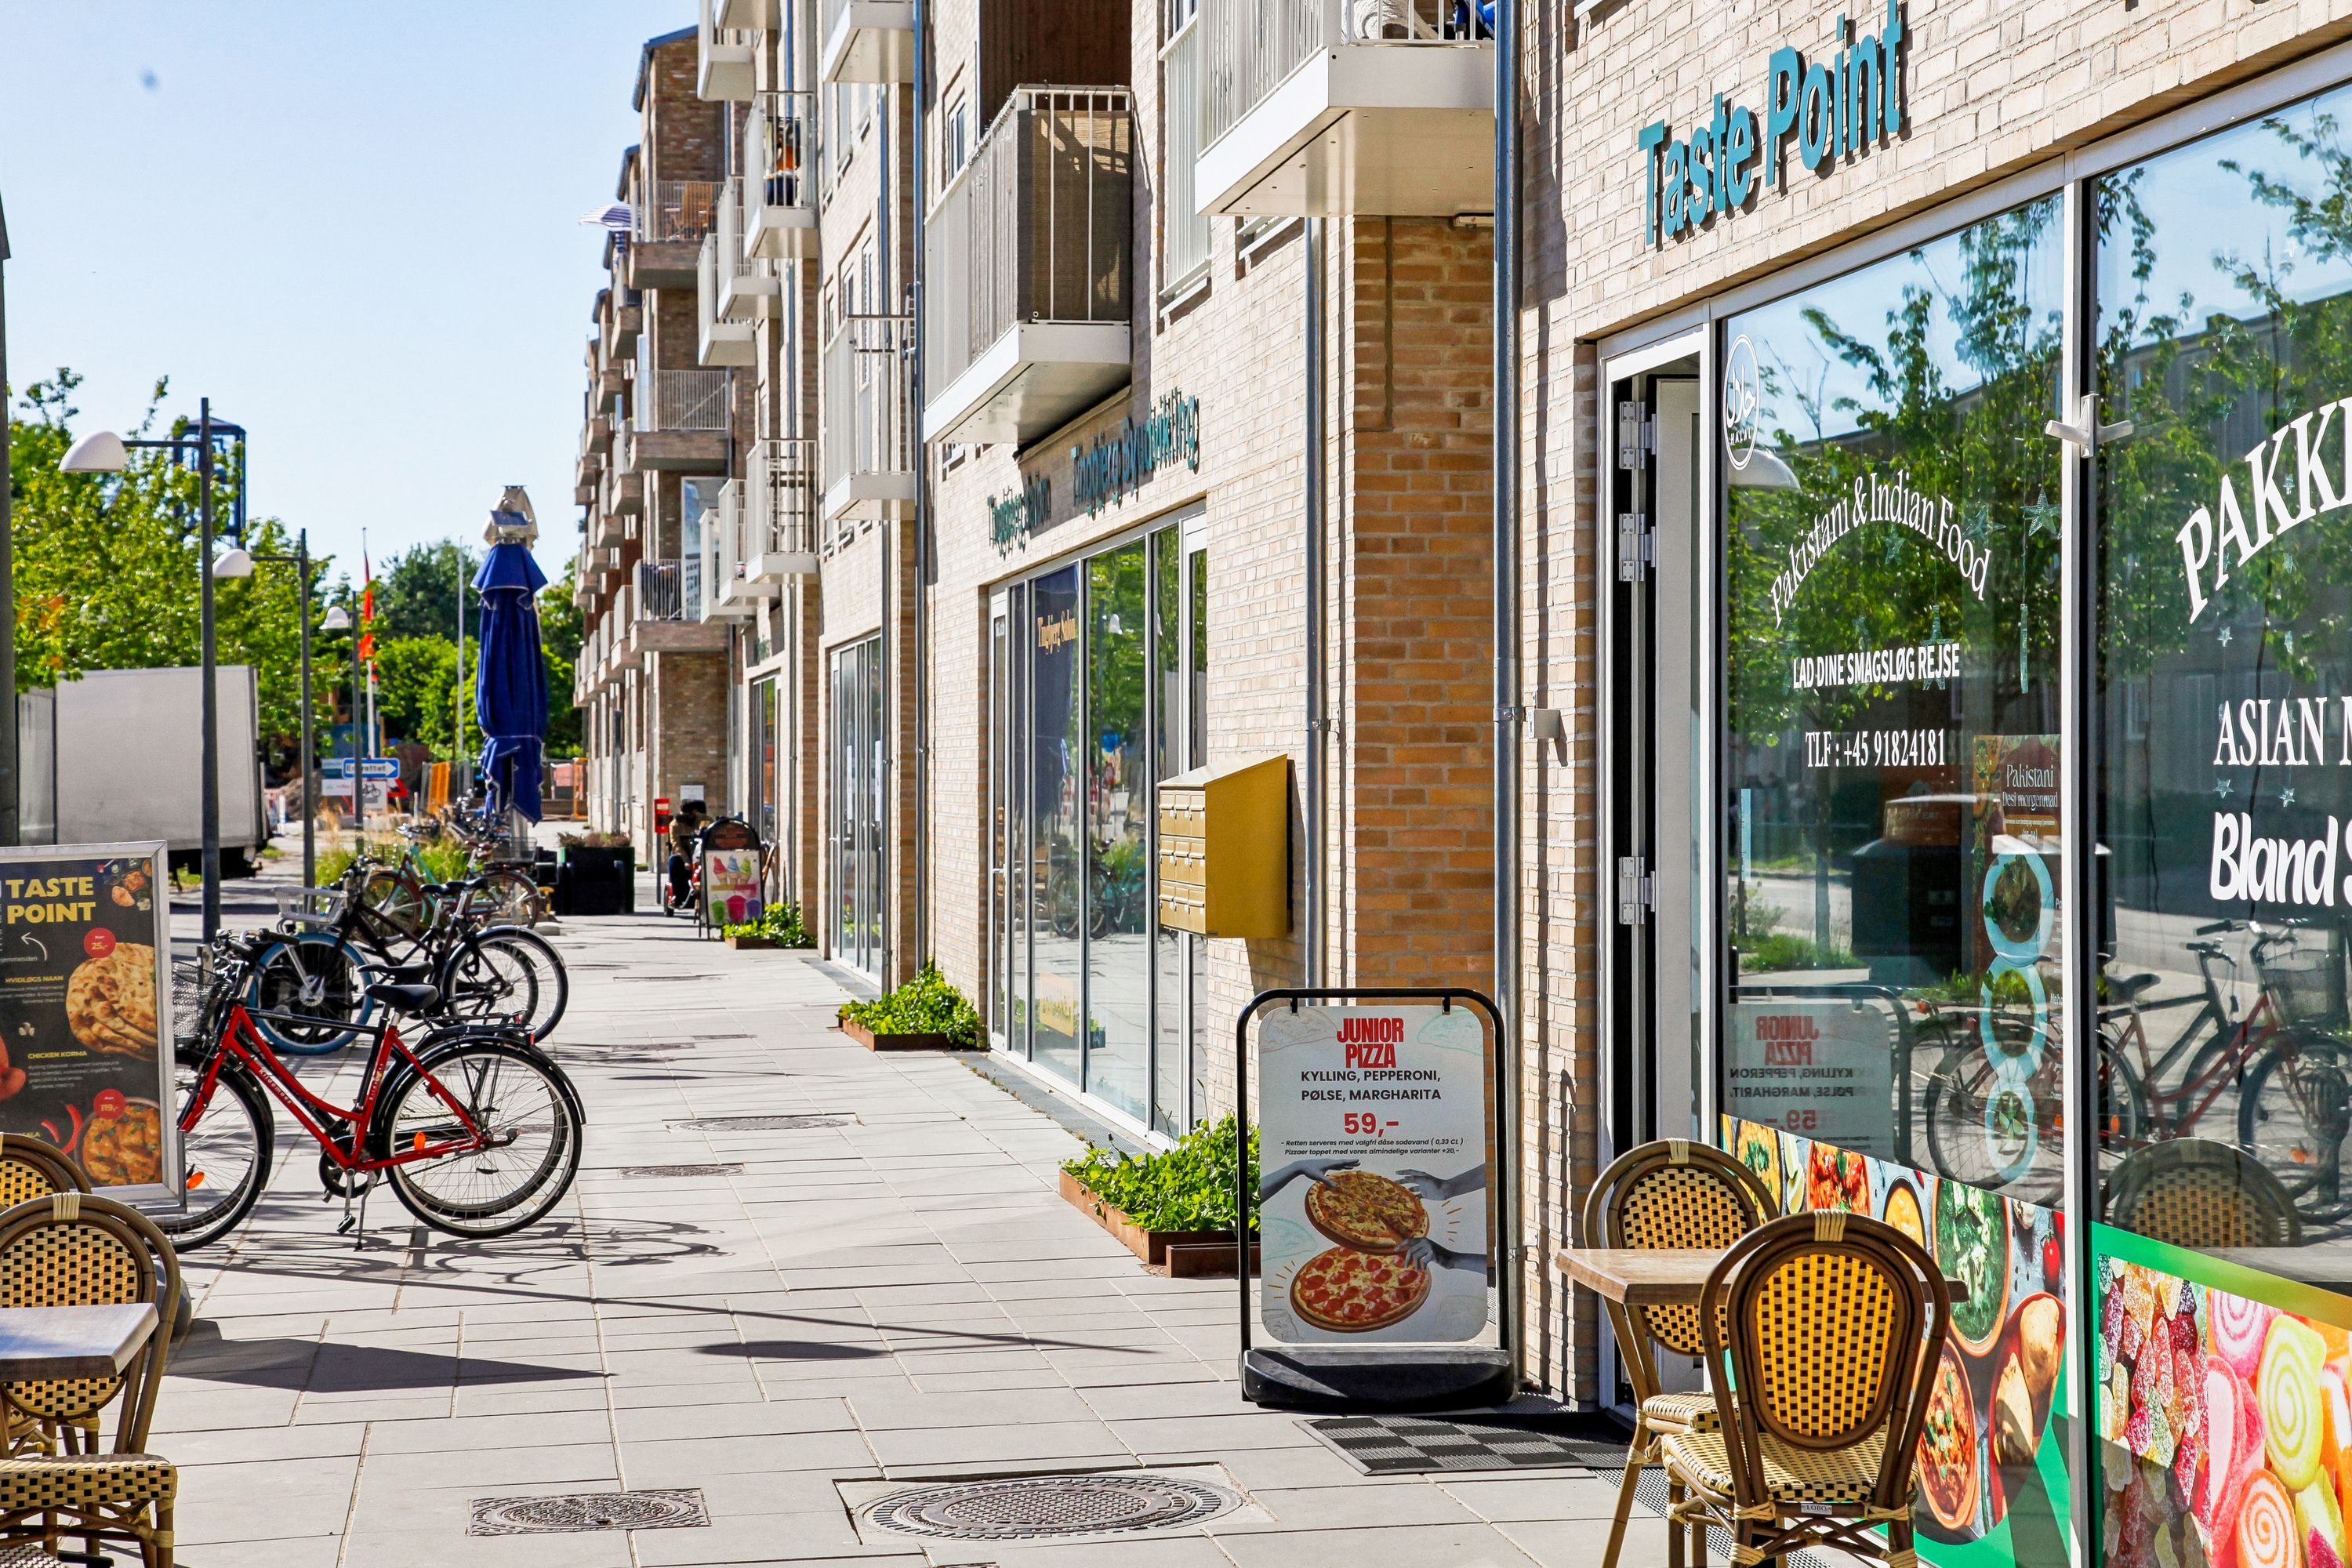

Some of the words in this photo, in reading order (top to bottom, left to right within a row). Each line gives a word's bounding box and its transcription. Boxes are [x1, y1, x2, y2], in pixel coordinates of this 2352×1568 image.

[1639, 92, 1752, 246] Taste
[1766, 0, 1903, 187] Point
[1730, 428, 1752, 445] HALAL
[1771, 483, 1850, 630] Pakistani
[1853, 476, 1868, 528] &
[1870, 469, 1934, 540] Indian
[1936, 495, 1991, 601] Food
[1793, 657, 1815, 689] LAD
[1817, 654, 1845, 687] DINE
[1846, 646, 1915, 686] SMAGSLØG
[1918, 643, 1960, 680] REJSE
[2213, 697, 2328, 766] ASIAN
[1805, 731, 1832, 768] TLF
[1843, 731, 1869, 768] +45
[1874, 728, 1946, 768] 91824181
[2006, 764, 2054, 788] Pakistani
[2002, 792, 2016, 807] Desi
[2209, 811, 2339, 906] Bland
[5, 877, 94, 898] TASTE
[7, 902, 96, 924] POINT
[1337, 1018, 1404, 1043] JUNIOR
[1345, 1044, 1396, 1068] PIZZA
[1301, 1071, 1360, 1083] KYLLING,
[1363, 1070, 1441, 1082] PEPPERONI,
[1301, 1089, 1346, 1102] PØLSE,
[1349, 1089, 1442, 1101] MARGHARITA
[1344, 1112, 1399, 1137] 59,-
